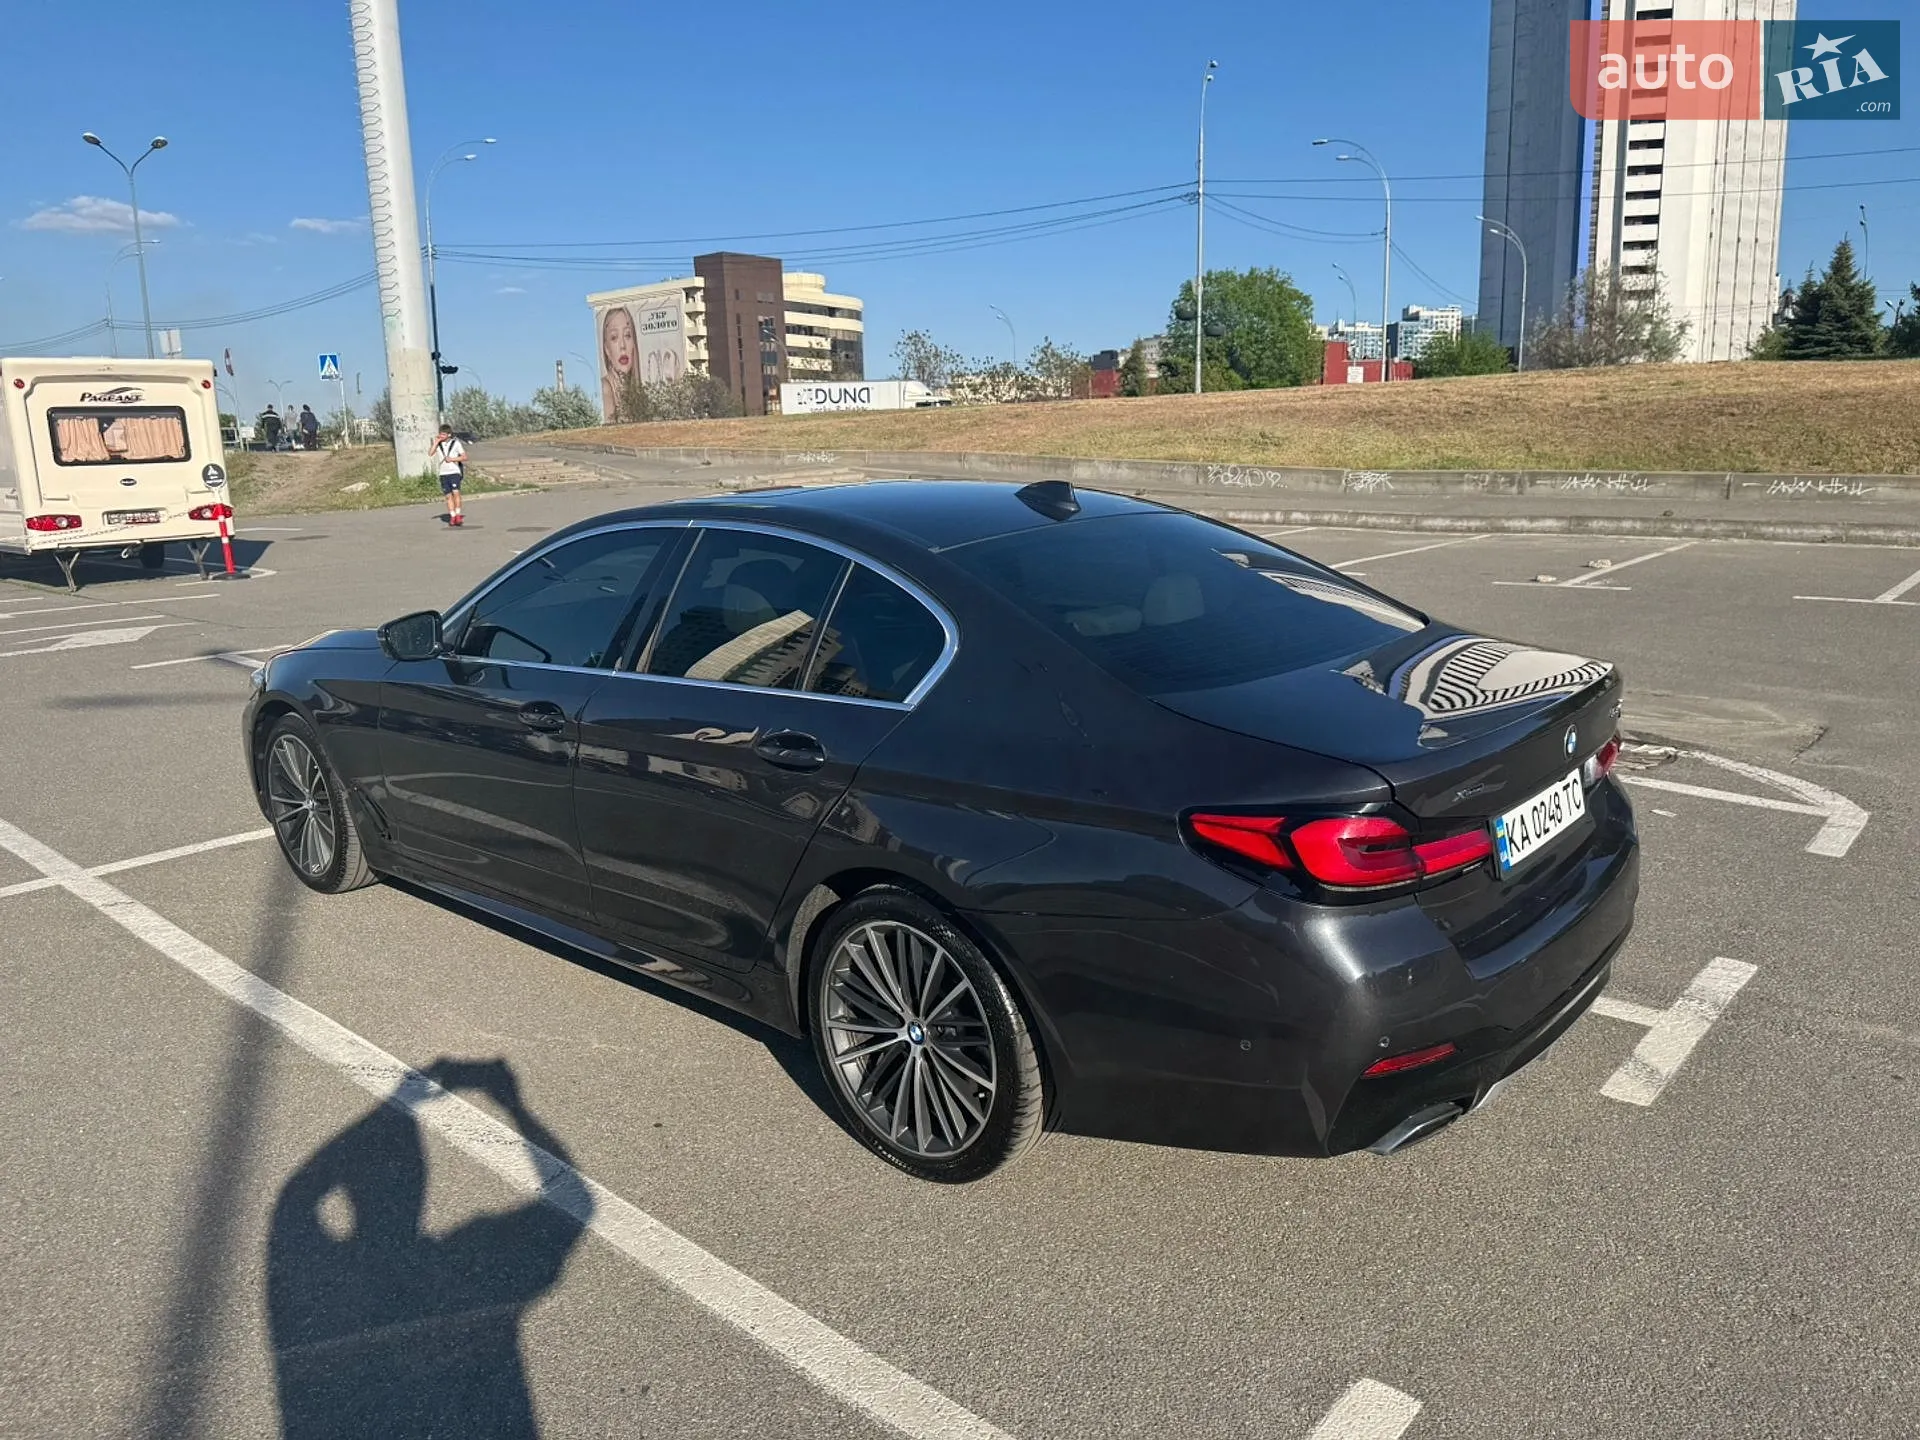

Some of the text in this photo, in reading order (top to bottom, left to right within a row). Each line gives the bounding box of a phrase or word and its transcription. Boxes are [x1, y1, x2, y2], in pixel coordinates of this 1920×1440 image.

[79, 391, 143, 404] PAGEANT
[1506, 814, 1532, 857] KA
[1531, 791, 1562, 839] 0248
[1562, 778, 1581, 816] TC
